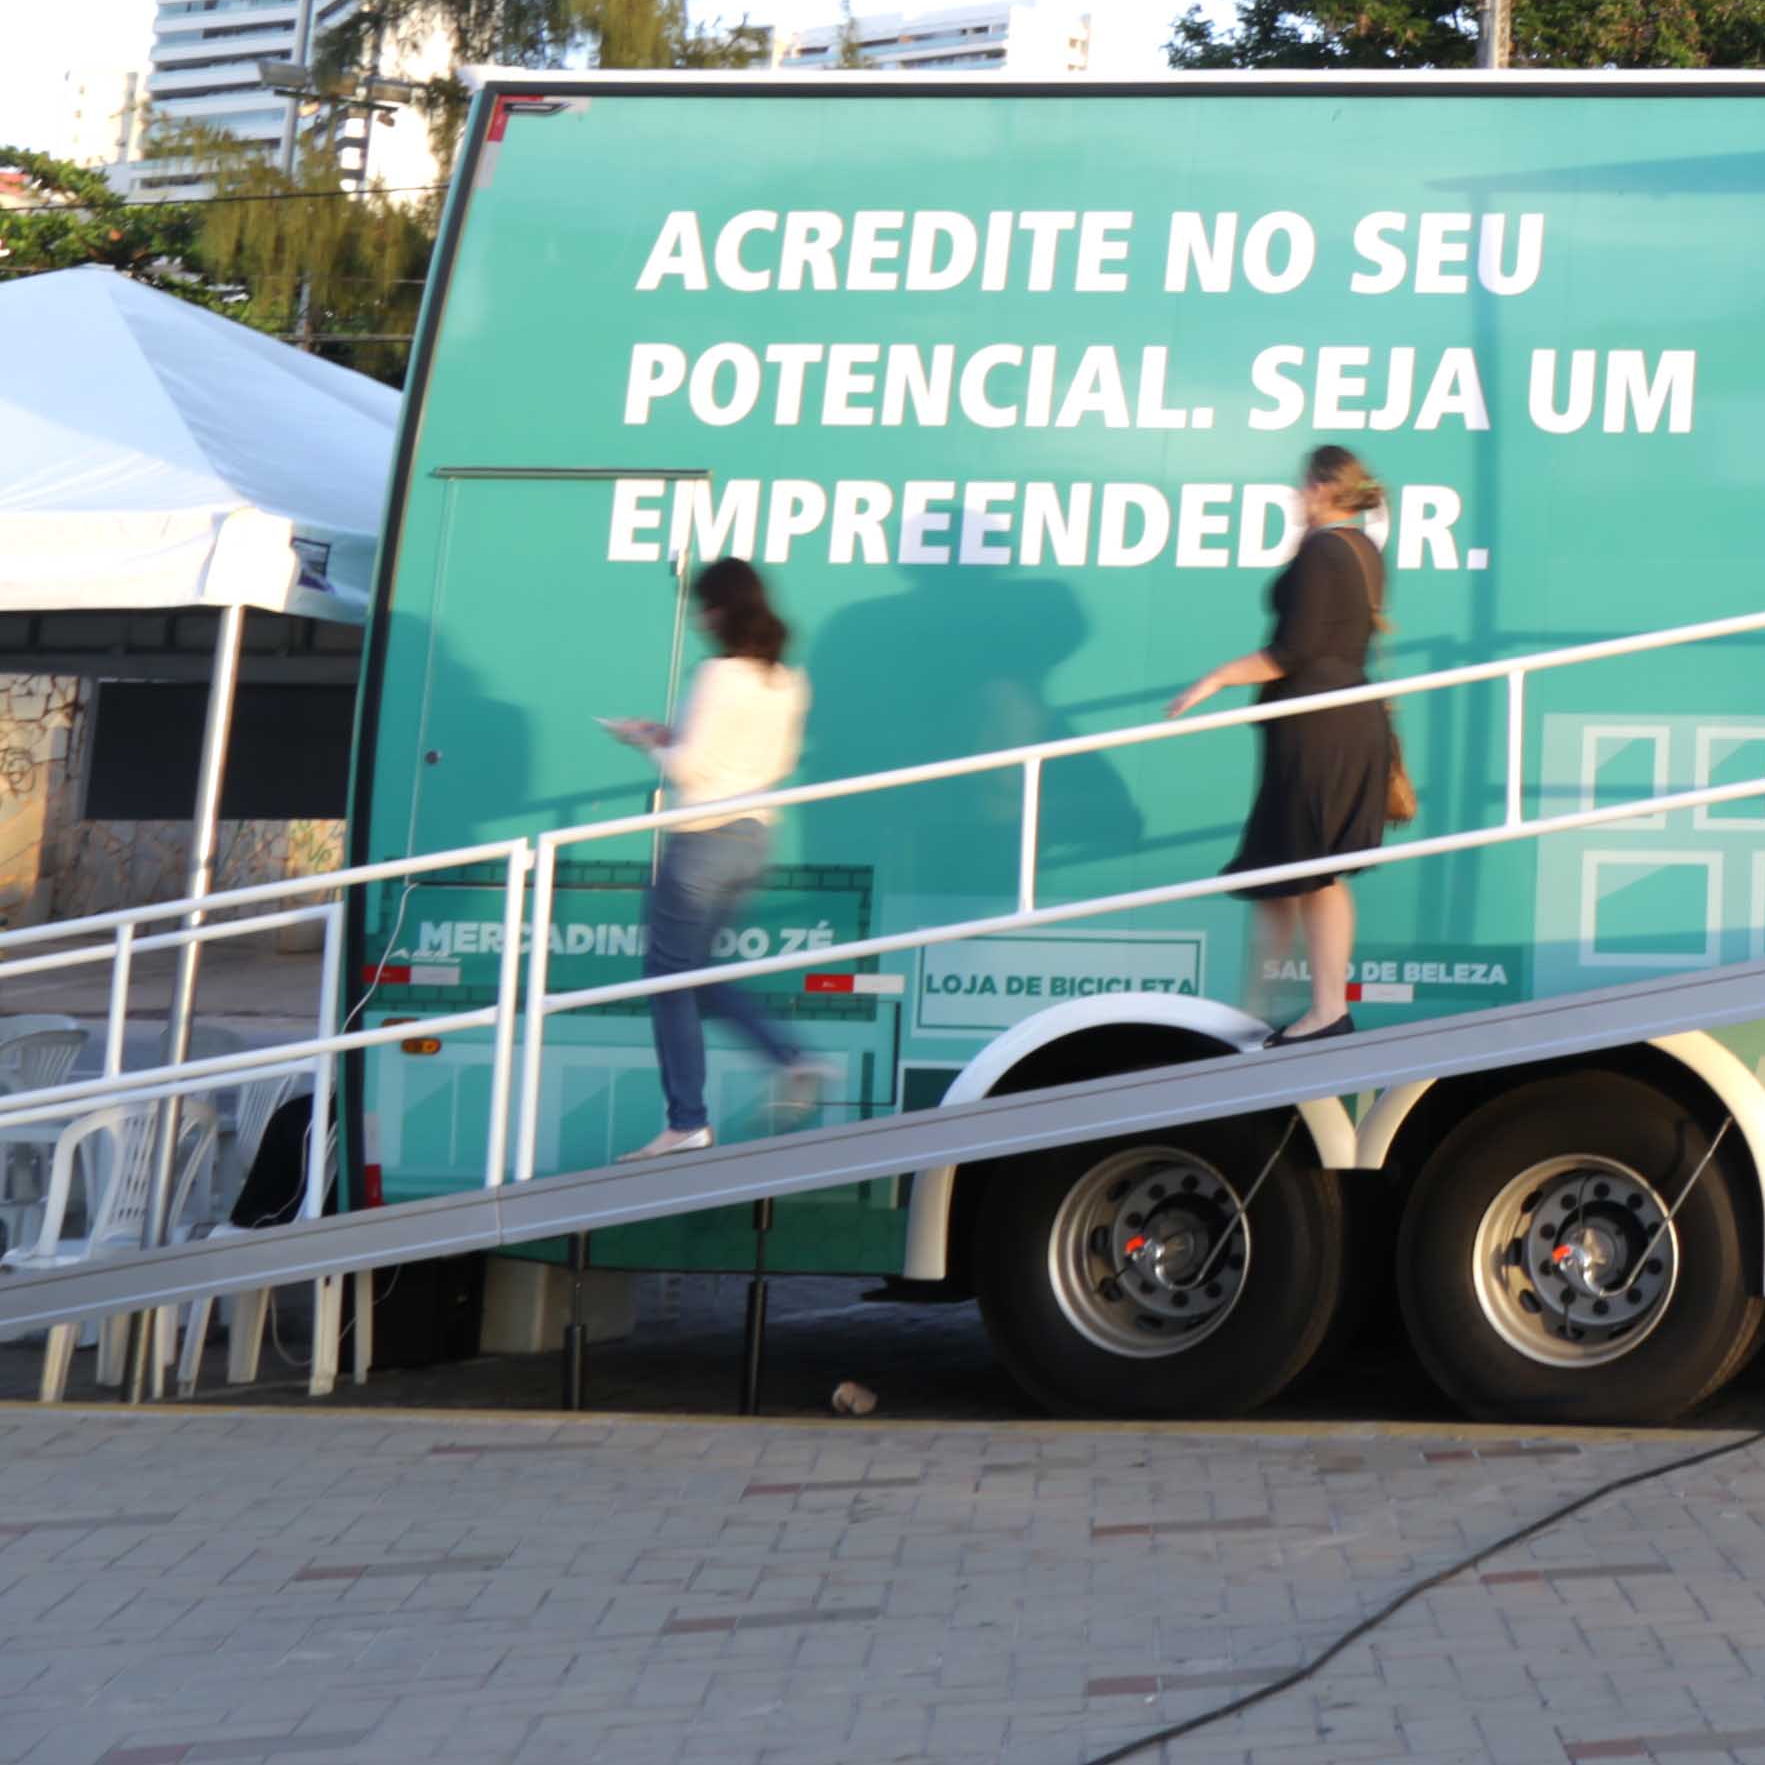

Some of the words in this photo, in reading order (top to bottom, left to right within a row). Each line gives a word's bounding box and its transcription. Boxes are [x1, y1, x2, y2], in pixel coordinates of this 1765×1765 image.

[634, 210, 1134, 292] ACREDITE
[1163, 210, 1316, 293] NO
[1350, 211, 1545, 295] SEU
[623, 342, 1215, 429] POTENCIAL.
[1248, 345, 1492, 431] SEJA
[1528, 348, 1697, 434] UM
[606, 478, 1490, 570] EMPREENDEDR.
[710, 926, 770, 960] DO
[778, 919, 835, 956] ZÉ
[926, 974, 998, 996] LOJA
[1005, 975, 1043, 996] DE
[1361, 961, 1397, 982] DE
[1403, 962, 1507, 985] BELEZA
